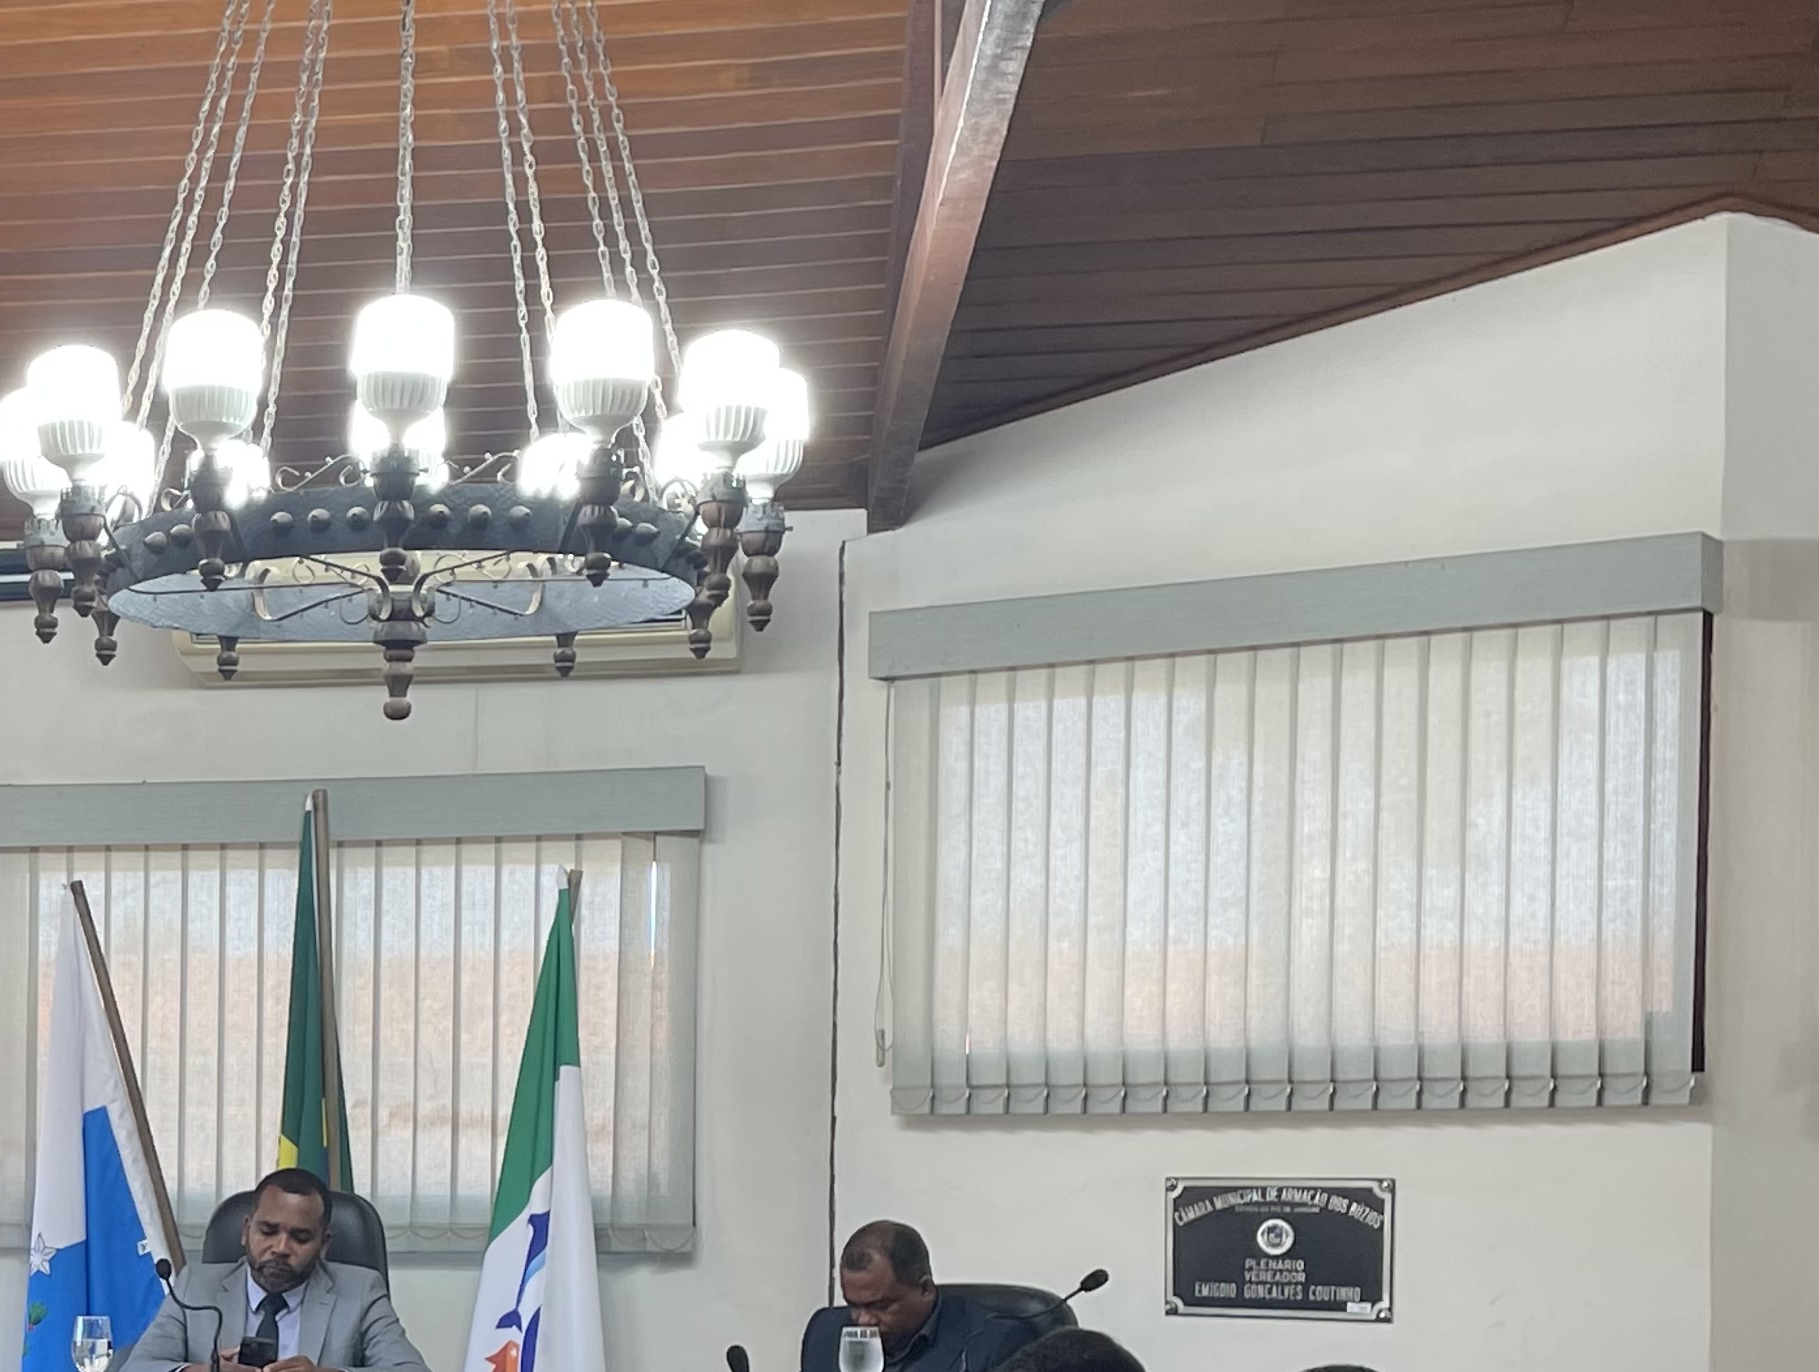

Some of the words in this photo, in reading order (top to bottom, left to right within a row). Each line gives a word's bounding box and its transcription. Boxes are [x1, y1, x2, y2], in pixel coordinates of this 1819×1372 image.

[1265, 1187, 1279, 1202] DE
[1244, 1271, 1306, 1283] VEREADOR
[1309, 1285, 1361, 1303] COUTINHO
